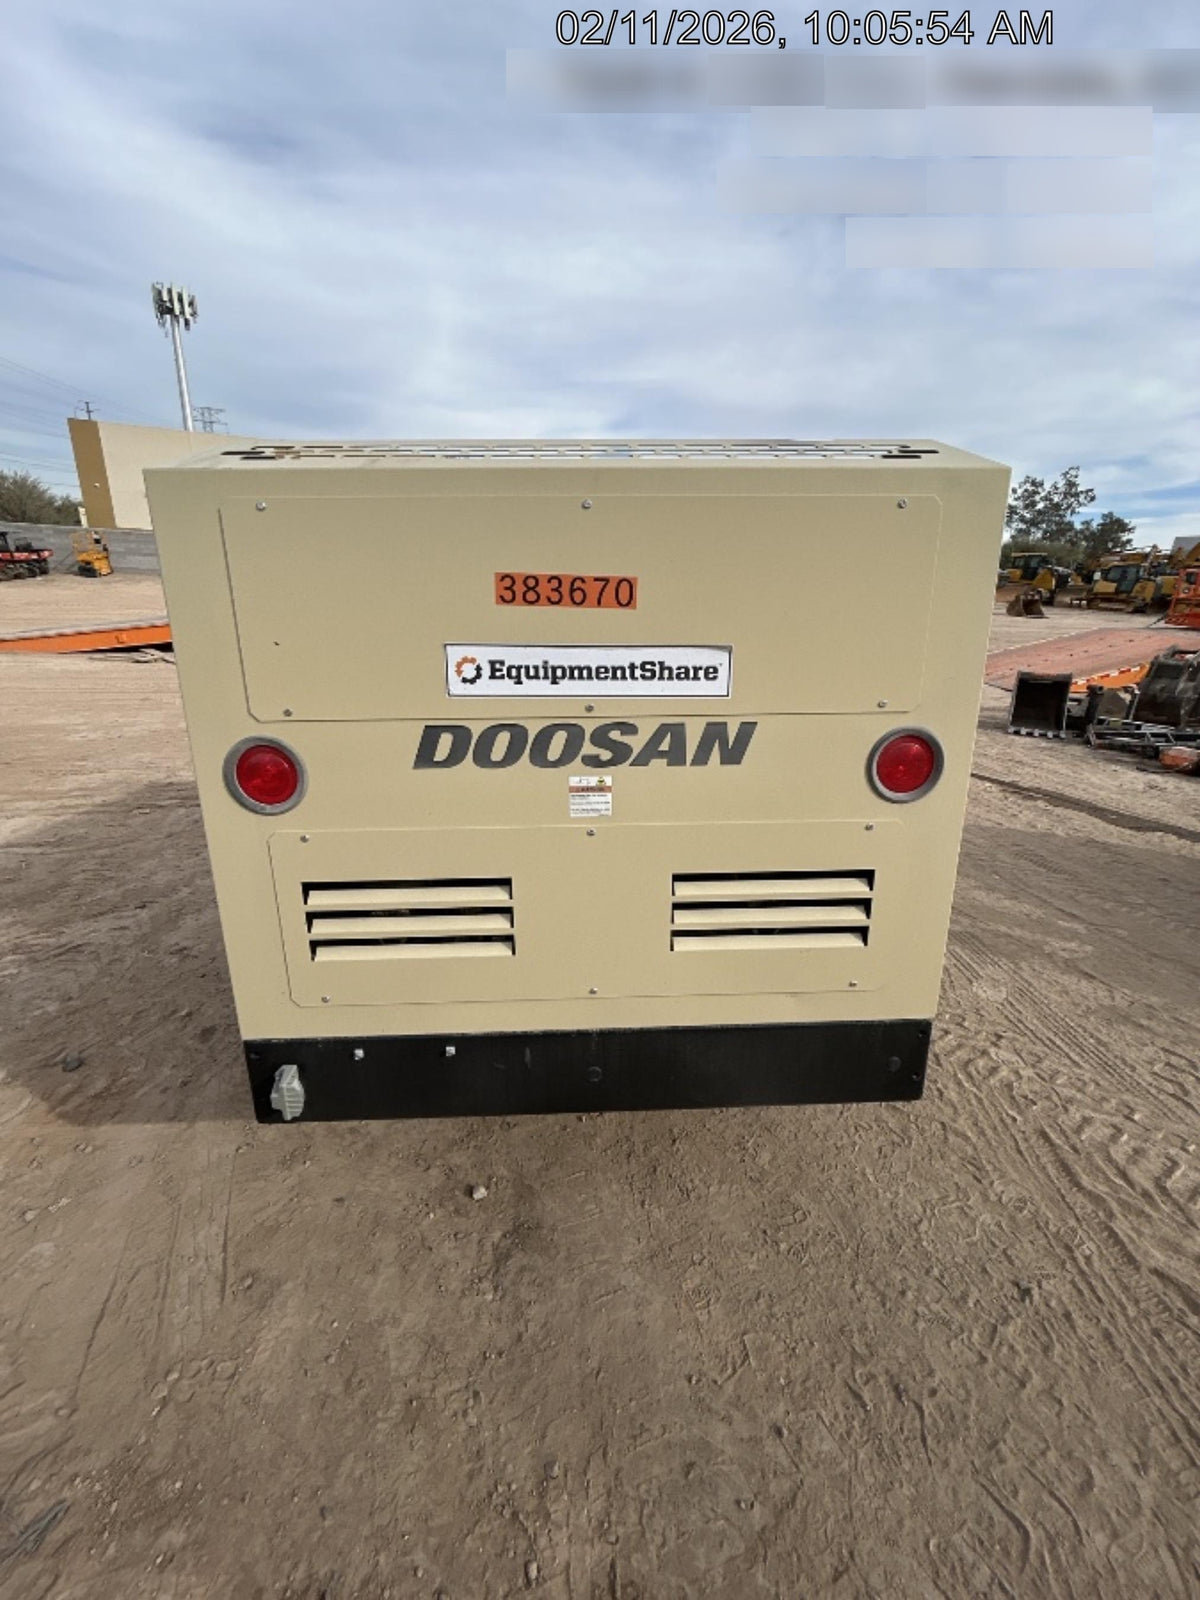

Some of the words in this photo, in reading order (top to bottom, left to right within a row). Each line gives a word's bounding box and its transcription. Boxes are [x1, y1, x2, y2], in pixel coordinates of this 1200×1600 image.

[498, 574, 635, 608] 383670
[488, 659, 720, 685] EquipmentShare
[412, 721, 759, 770] DOOSAN
